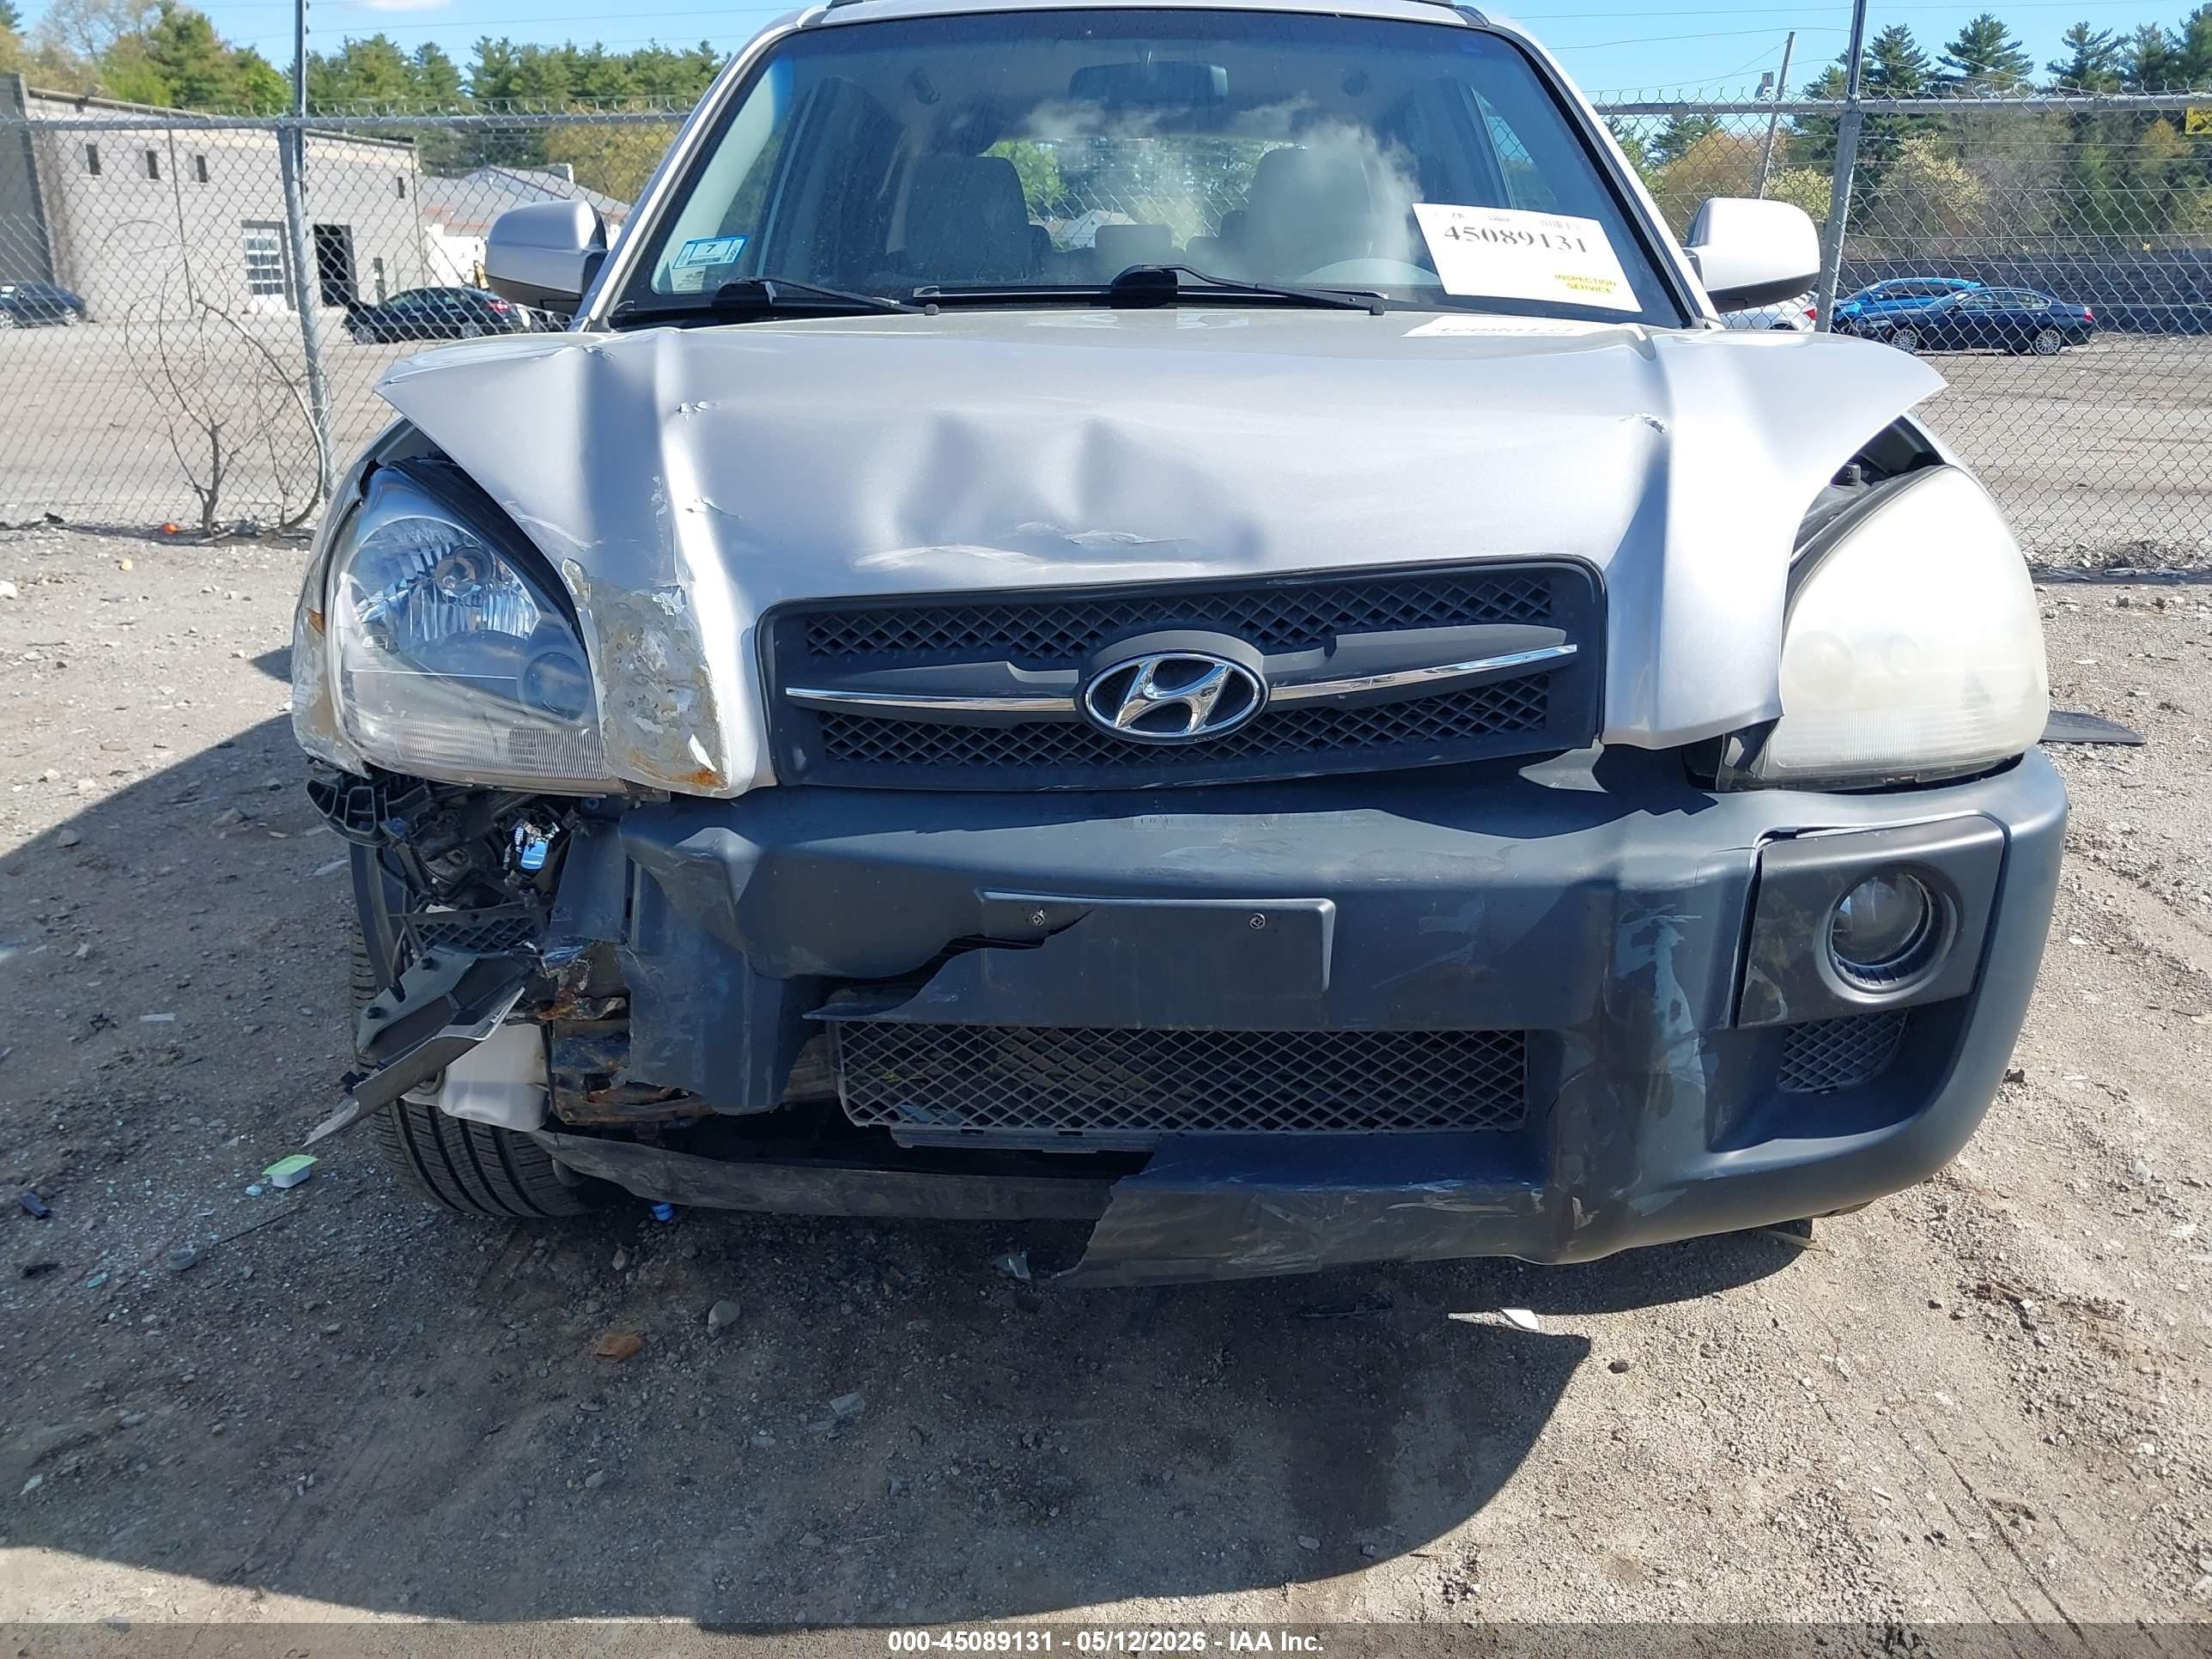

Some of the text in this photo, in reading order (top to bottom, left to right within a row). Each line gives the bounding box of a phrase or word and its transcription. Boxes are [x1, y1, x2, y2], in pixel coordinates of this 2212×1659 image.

[1443, 226, 1588, 253] 45089131
[706, 244, 716, 254] 7
[1554, 274, 1617, 287] INSPECTION
[1565, 283, 1615, 295] SERVICE
